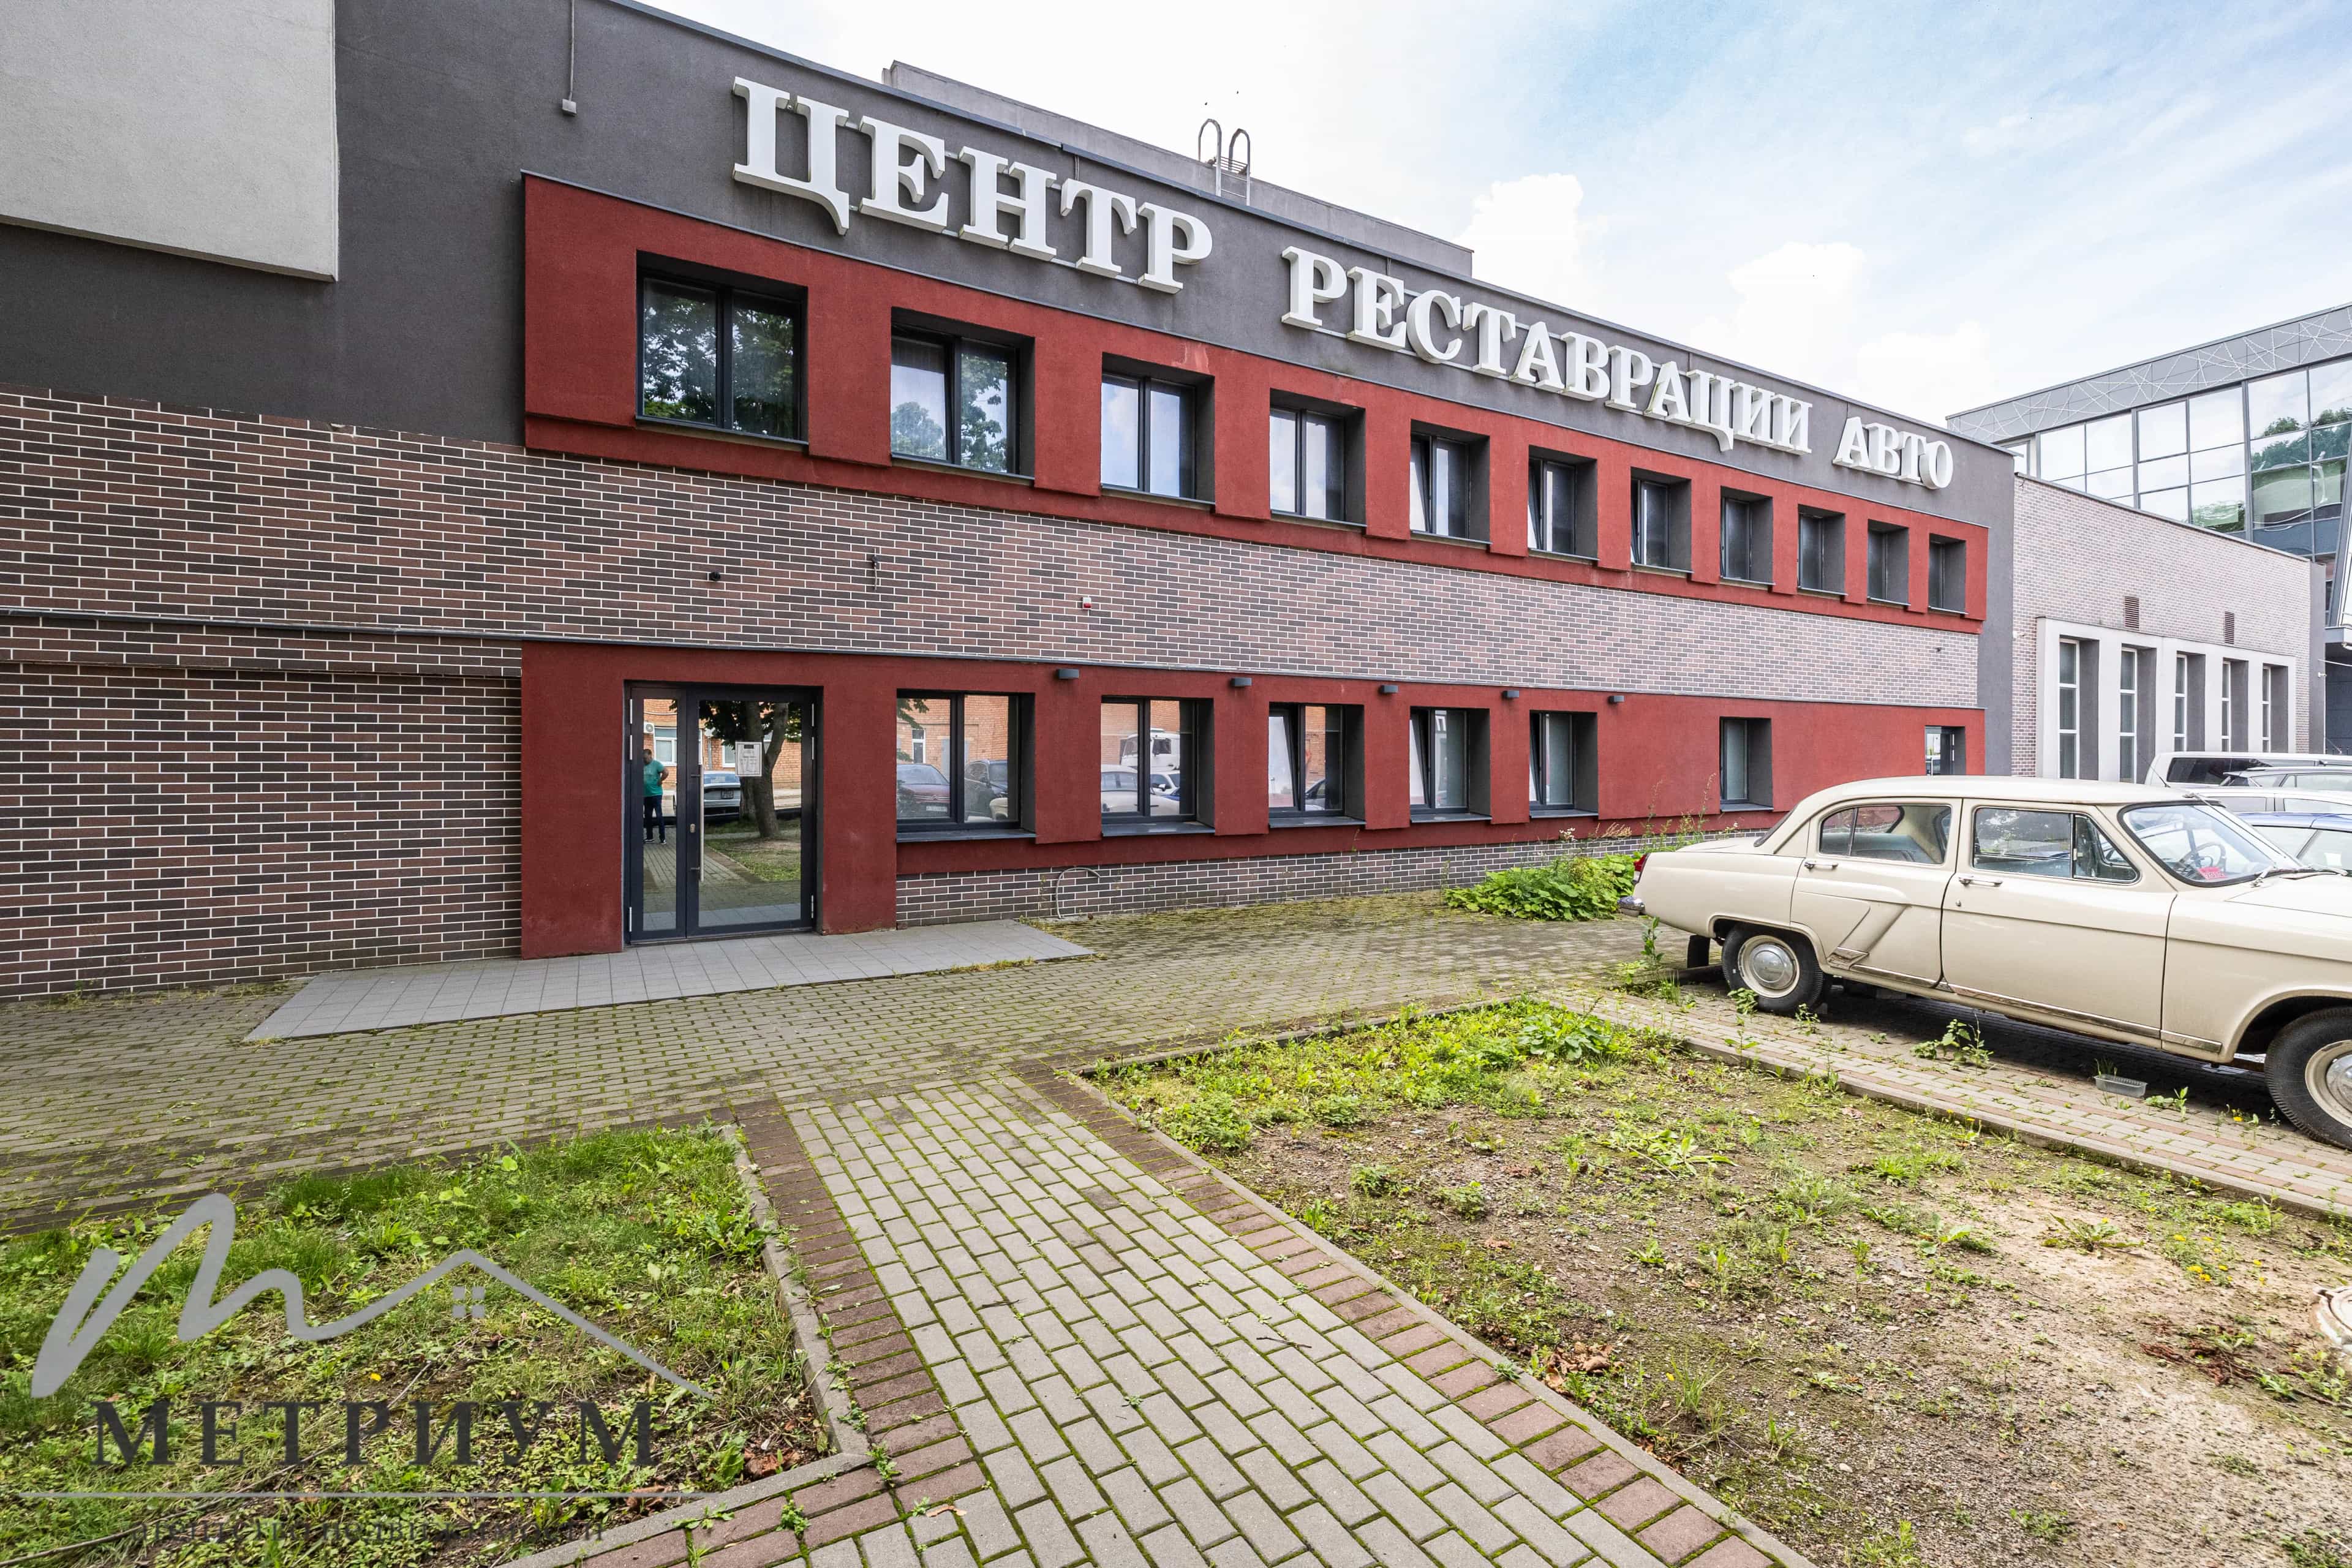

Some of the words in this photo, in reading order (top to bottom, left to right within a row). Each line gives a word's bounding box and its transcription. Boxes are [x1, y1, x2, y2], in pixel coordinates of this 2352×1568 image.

[732, 76, 1213, 295] ЦЕНТР
[1281, 246, 1812, 455] РЕСТАВРАЦИИ
[1833, 416, 1953, 490] АВТО
